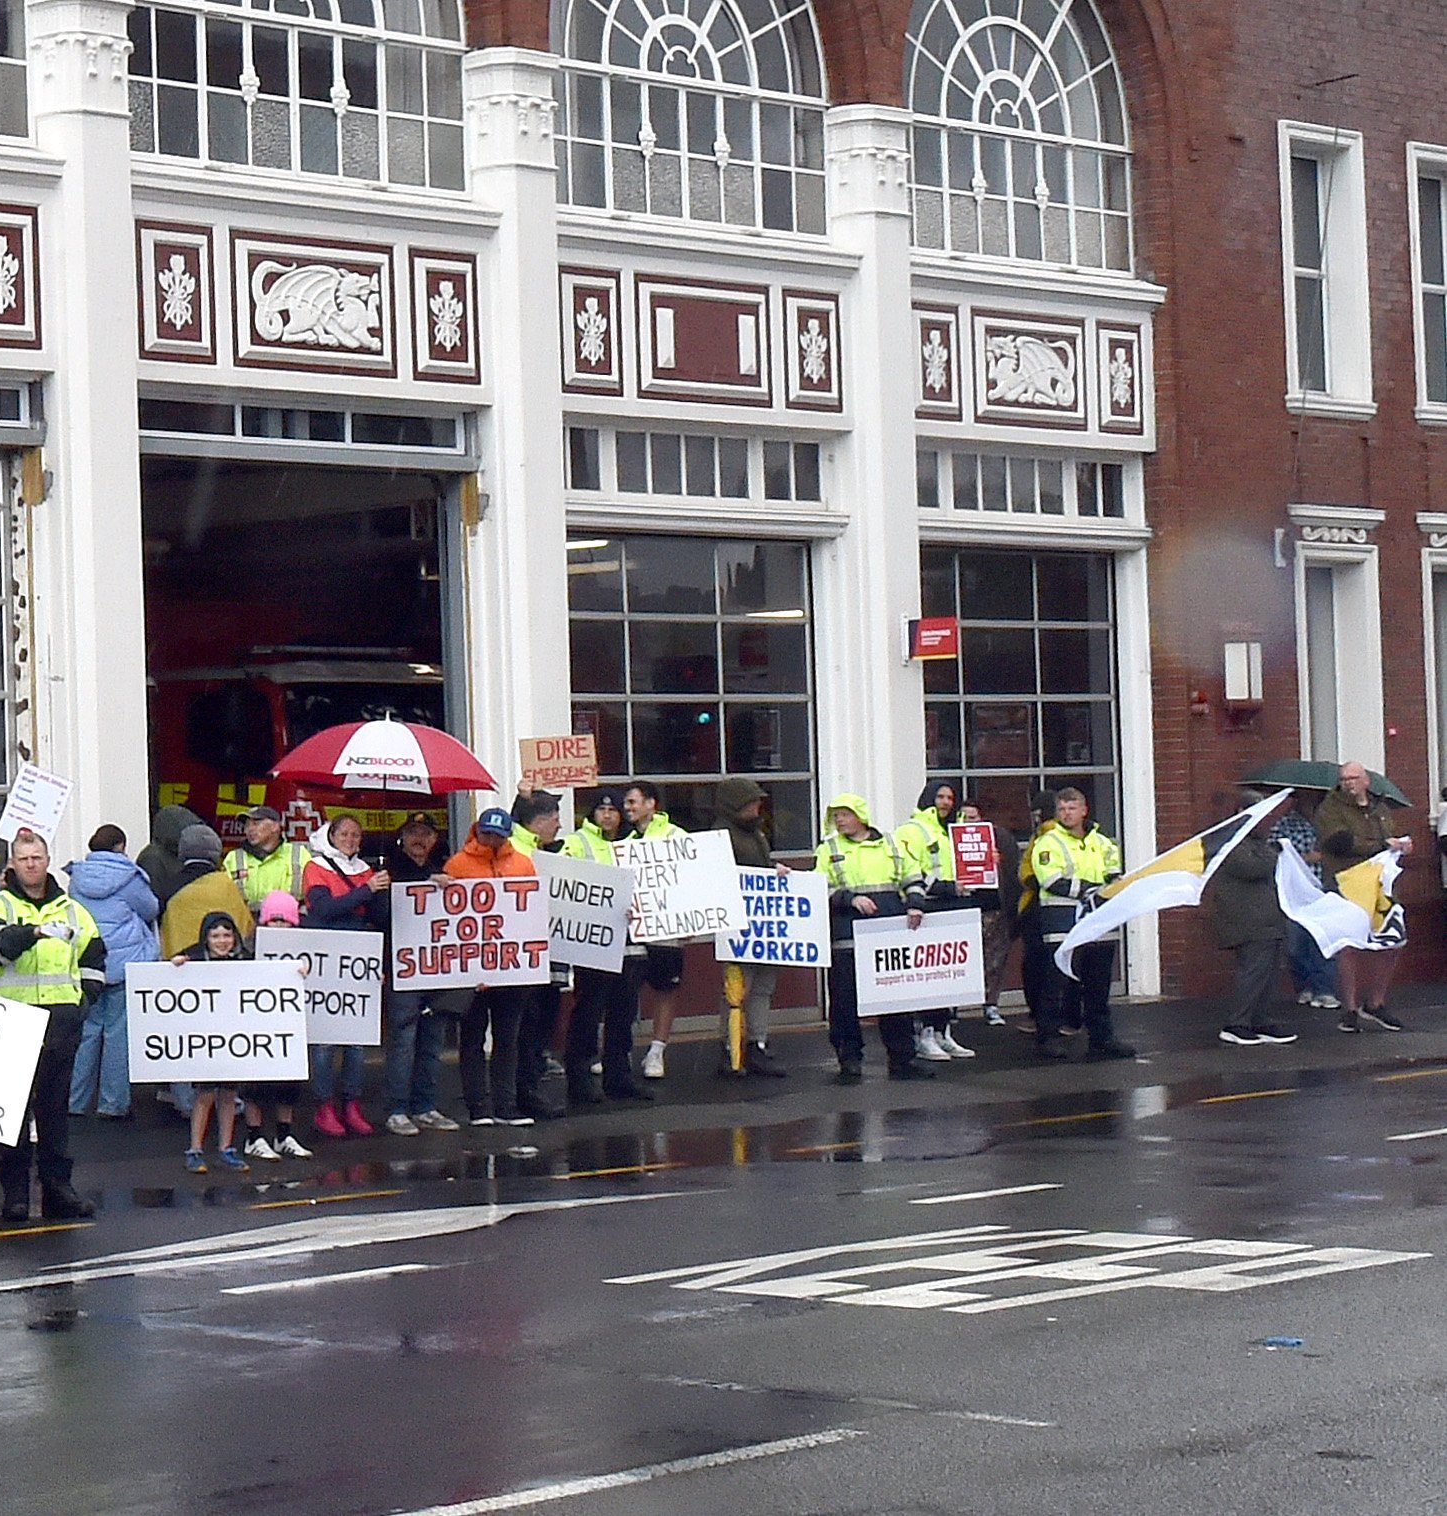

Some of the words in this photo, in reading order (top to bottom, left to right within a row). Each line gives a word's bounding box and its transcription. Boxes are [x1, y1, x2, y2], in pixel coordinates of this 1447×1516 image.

[346, 756, 415, 766] NZBLOOD
[536, 737, 590, 762] DIRE
[523, 765, 600, 783] EMERGENCY
[221, 820, 245, 835] FIR
[613, 836, 698, 867] FAILING
[406, 880, 539, 916] TOOT
[549, 877, 615, 909] UNDER
[742, 894, 812, 918] TAFFED
[430, 914, 505, 943] FOR
[632, 907, 731, 938] ZEALANDER
[739, 919, 789, 939] OVER
[396, 940, 549, 979] SUPPORT
[727, 937, 819, 963] WORKED
[874, 946, 912, 973] FIRE
[913, 940, 969, 969] CRISIS
[339, 956, 380, 982] FOR
[875, 974, 906, 986] support
[906, 974, 915, 983] us
[915, 972, 925, 982] to
[925, 969, 952, 982] protect
[952, 968, 966, 980] you
[134, 988, 221, 1014] TOOT
[239, 987, 302, 1014] FOR
[144, 1033, 294, 1061] SUPPORT
